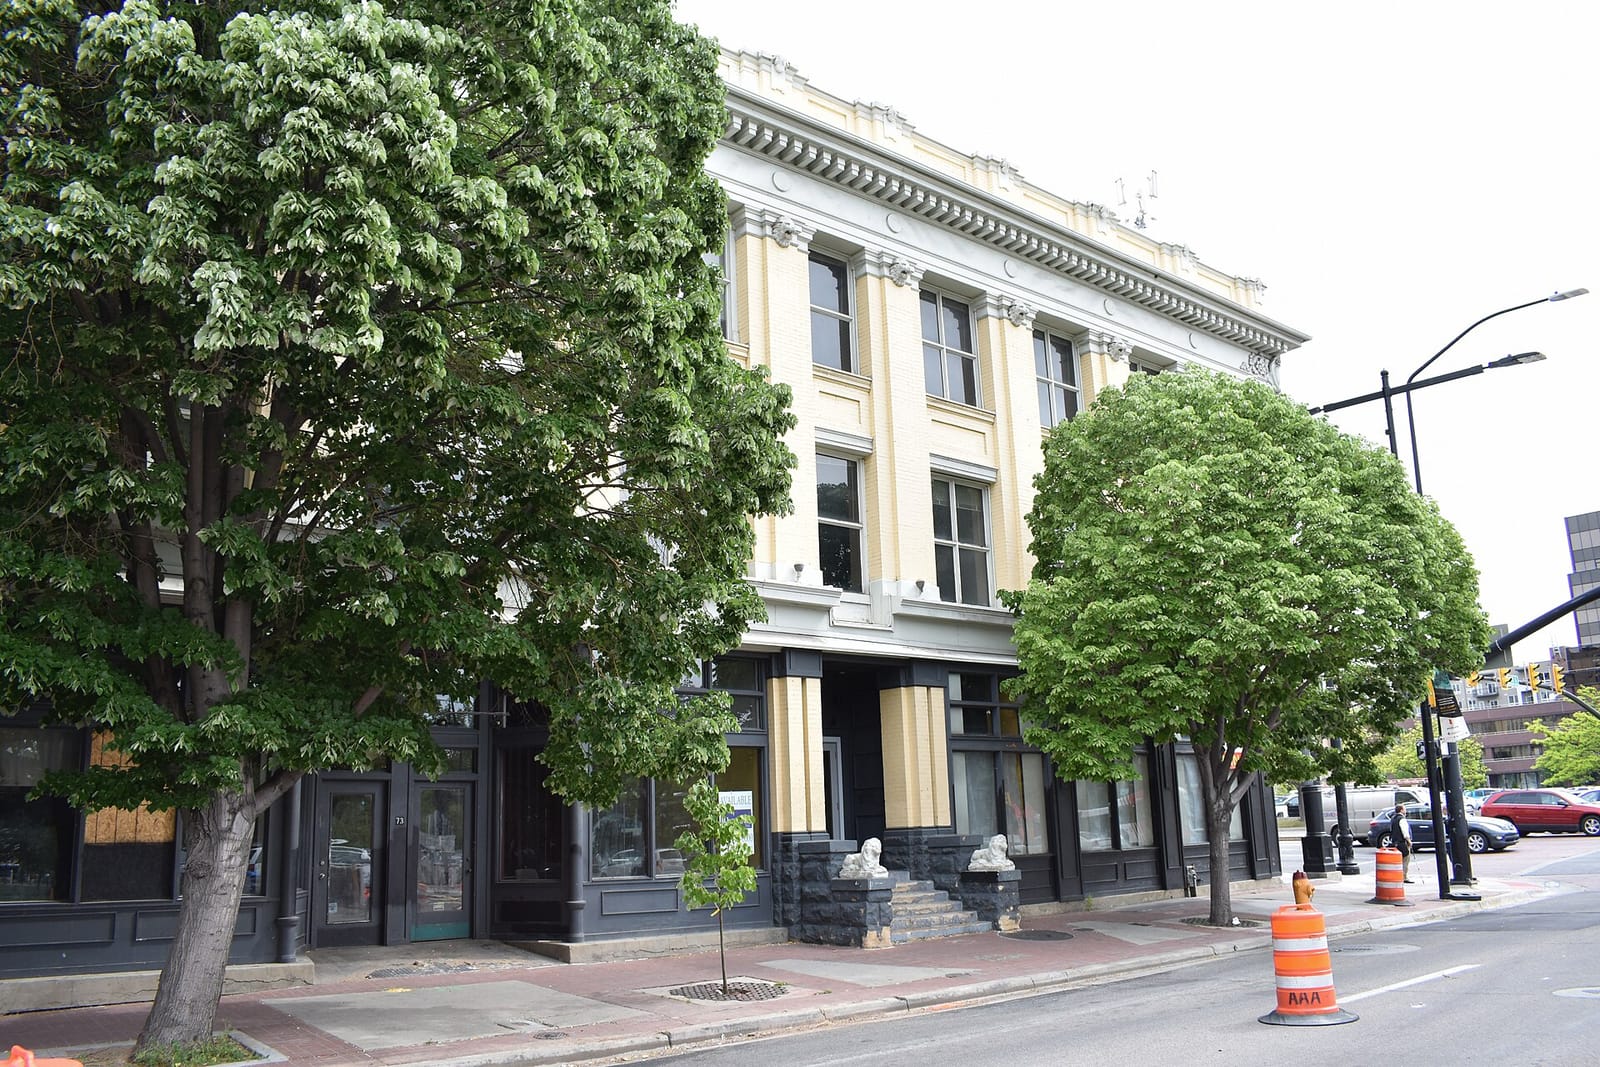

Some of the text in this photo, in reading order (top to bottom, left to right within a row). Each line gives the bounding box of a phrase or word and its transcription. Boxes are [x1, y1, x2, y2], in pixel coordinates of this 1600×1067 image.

[720, 795, 751, 805] AVAILABLE
[395, 816, 404, 825] 73
[1288, 991, 1321, 1005] AAA
